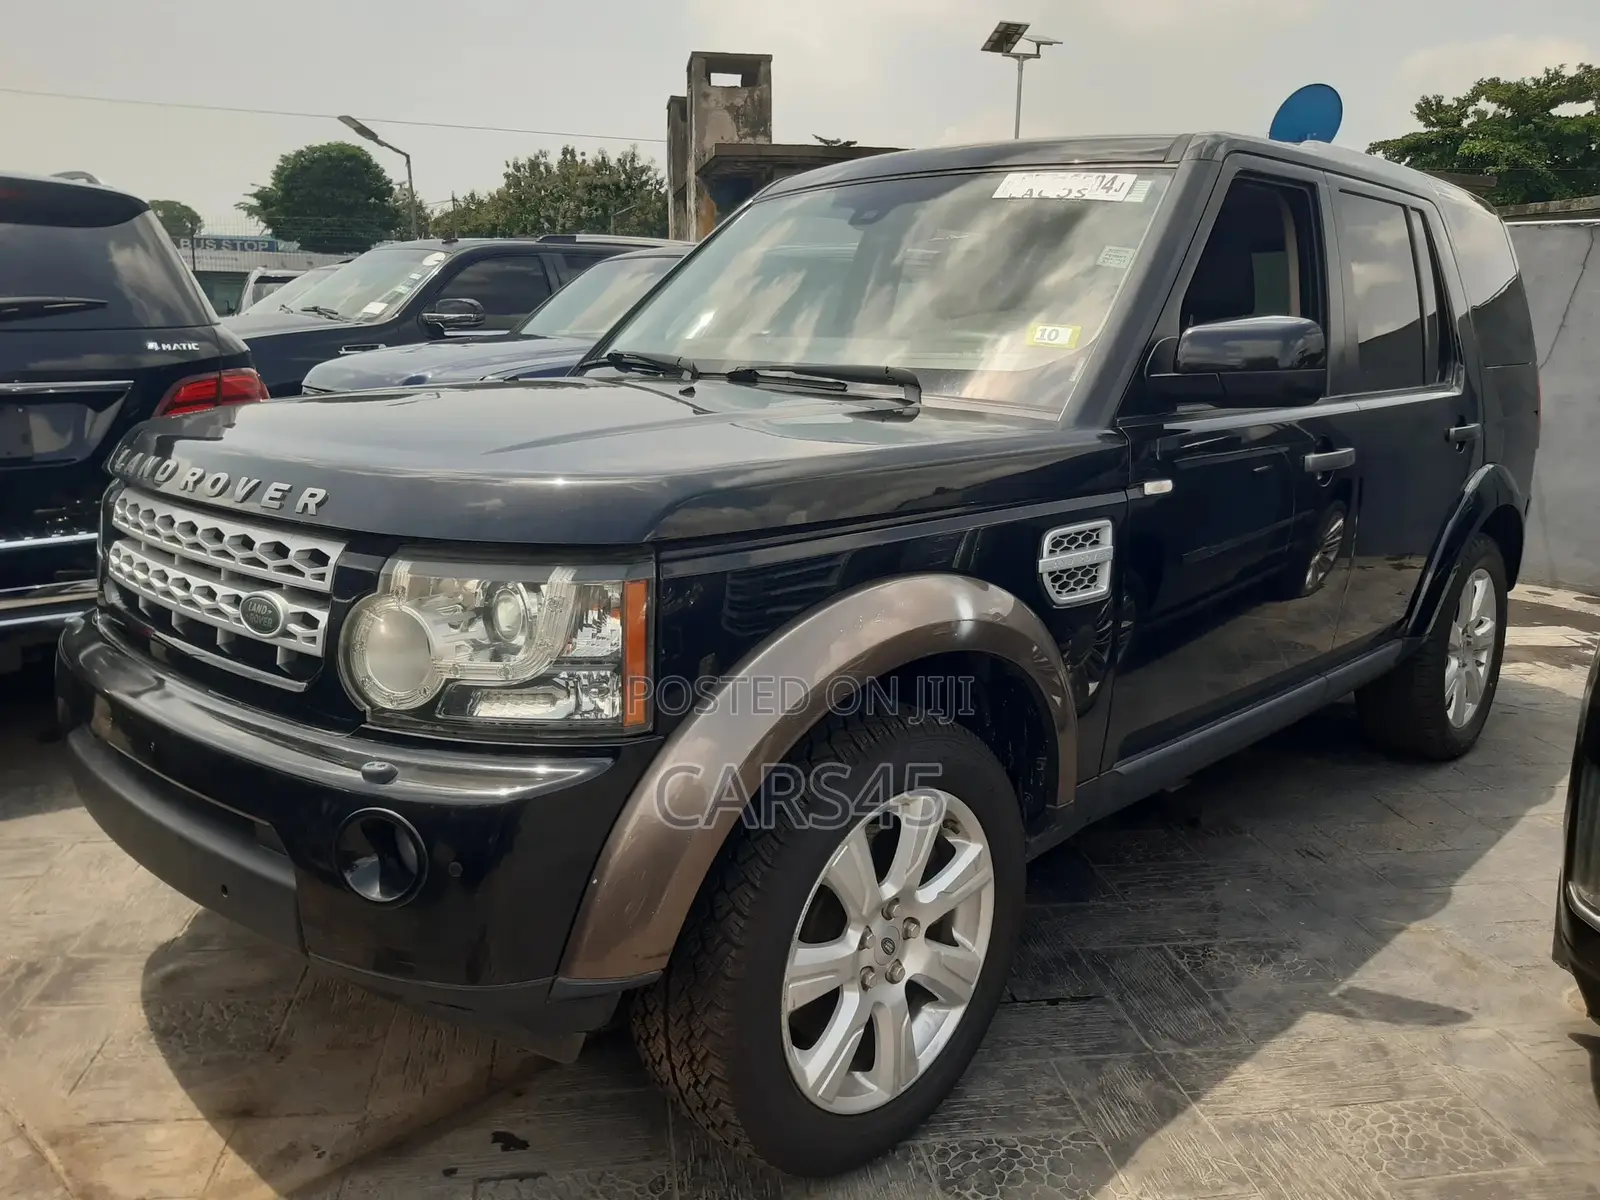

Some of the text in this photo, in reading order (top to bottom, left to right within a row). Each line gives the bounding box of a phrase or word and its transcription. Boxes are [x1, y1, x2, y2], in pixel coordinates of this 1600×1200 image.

[180, 238, 269, 252] BUS STOP
[1035, 328, 1060, 341] 10
[114, 448, 328, 515] LAND ROVER
[248, 601, 268, 615] LAND
[250, 612, 273, 628] ROVER
